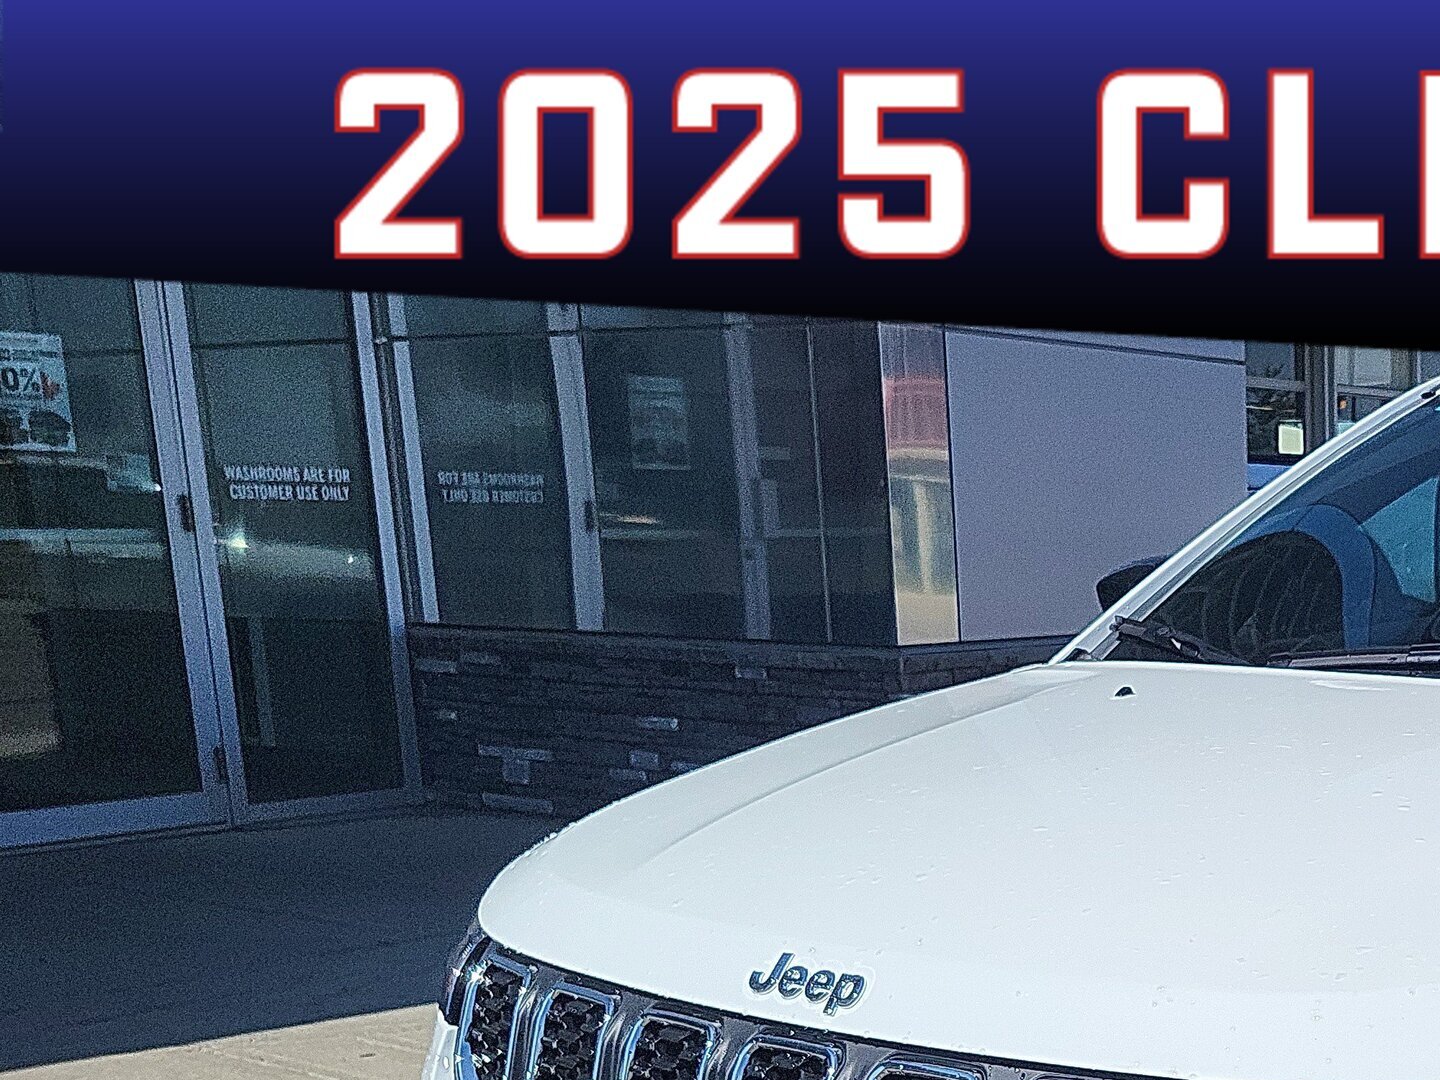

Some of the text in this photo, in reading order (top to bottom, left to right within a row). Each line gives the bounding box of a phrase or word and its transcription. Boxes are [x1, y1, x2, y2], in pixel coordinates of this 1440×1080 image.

[223, 465, 350, 482] WASHROOMS ARE FOR
[229, 483, 349, 500] CUSTOMER USE ONLY
[749, 952, 866, 1016] Jeep
